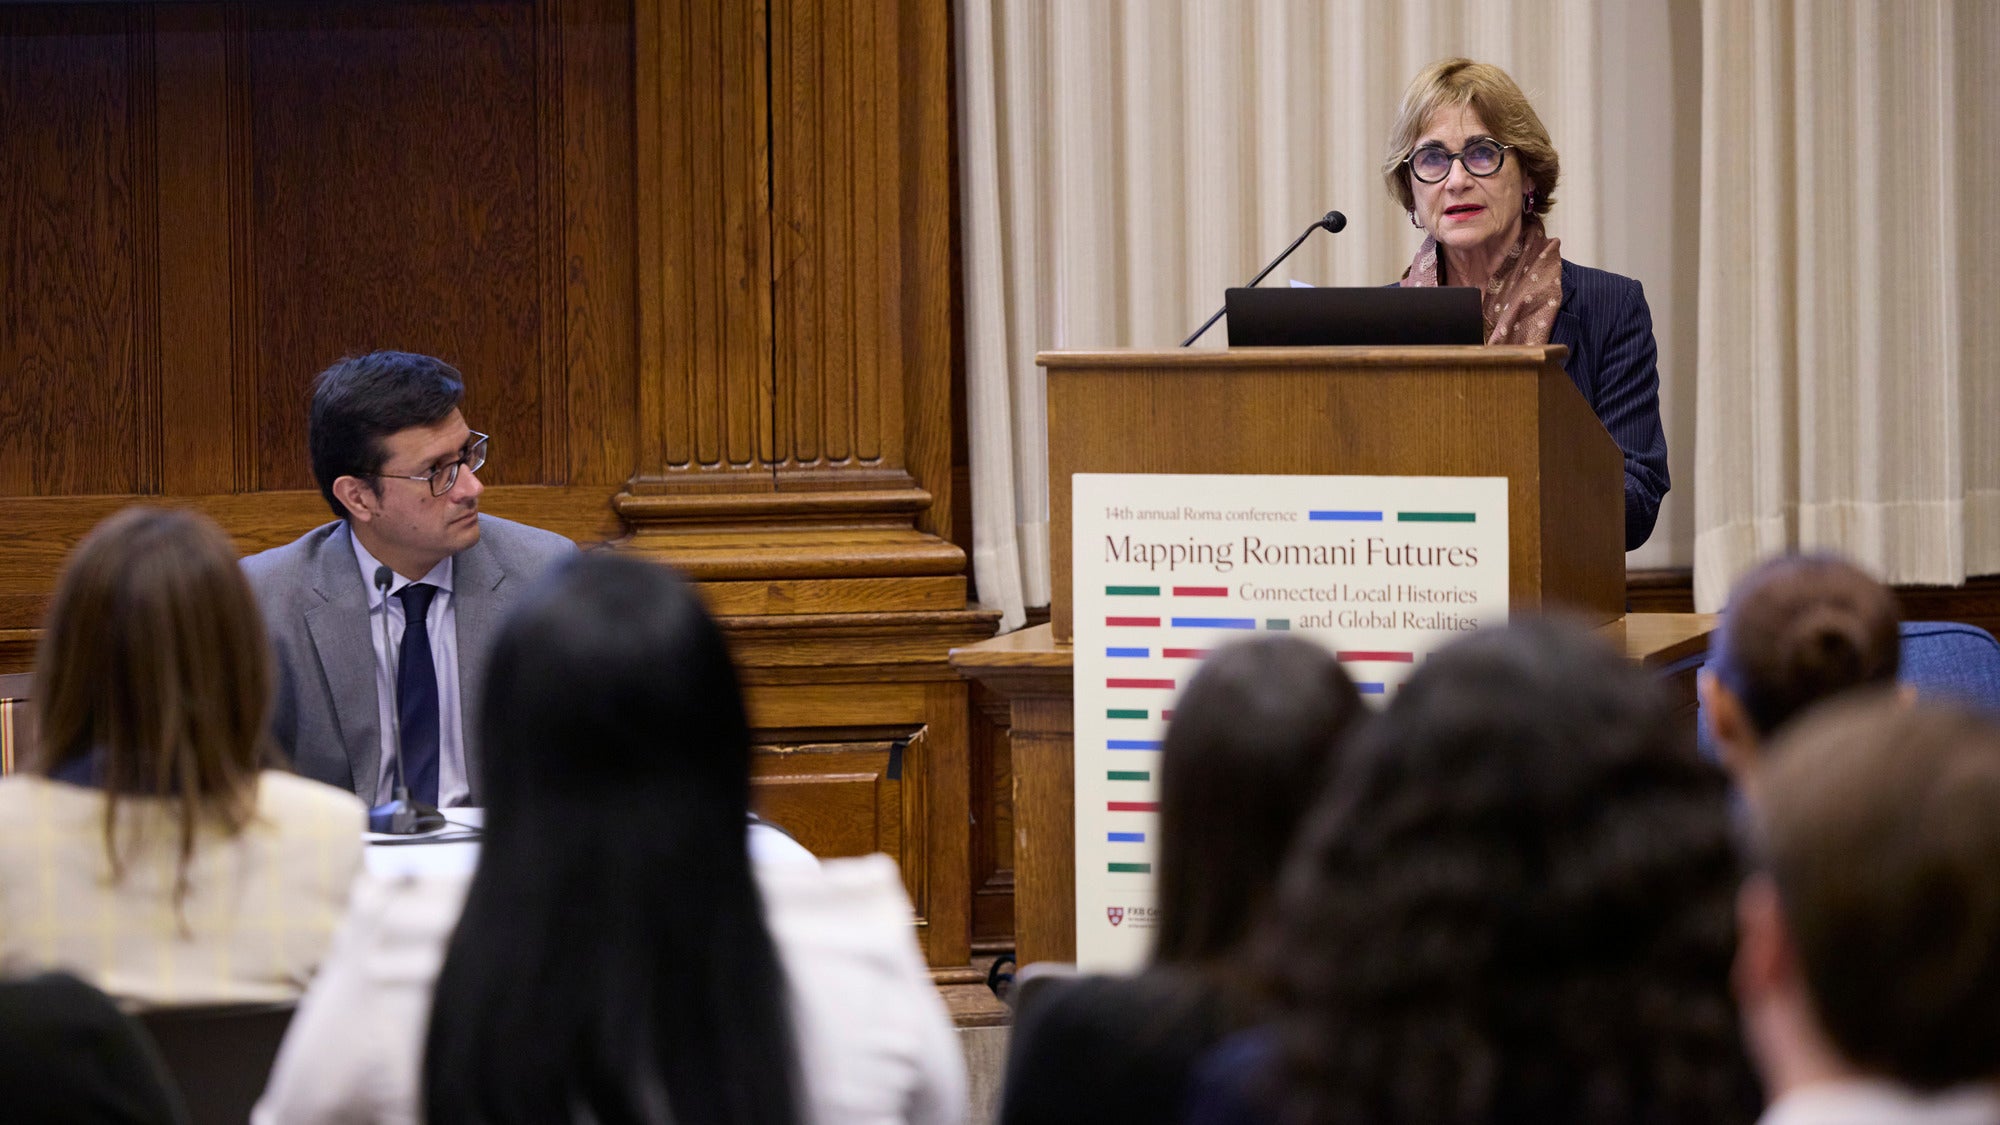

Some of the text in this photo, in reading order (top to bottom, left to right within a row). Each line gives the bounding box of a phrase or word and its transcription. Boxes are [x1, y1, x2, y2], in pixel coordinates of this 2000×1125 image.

[1105, 507, 1298, 522] 14th annual Roma conference
[1105, 535, 1479, 573] Mapping Romani Futures
[1239, 583, 1478, 604] Connected Local Histories
[1299, 611, 1478, 631] and Global Realities
